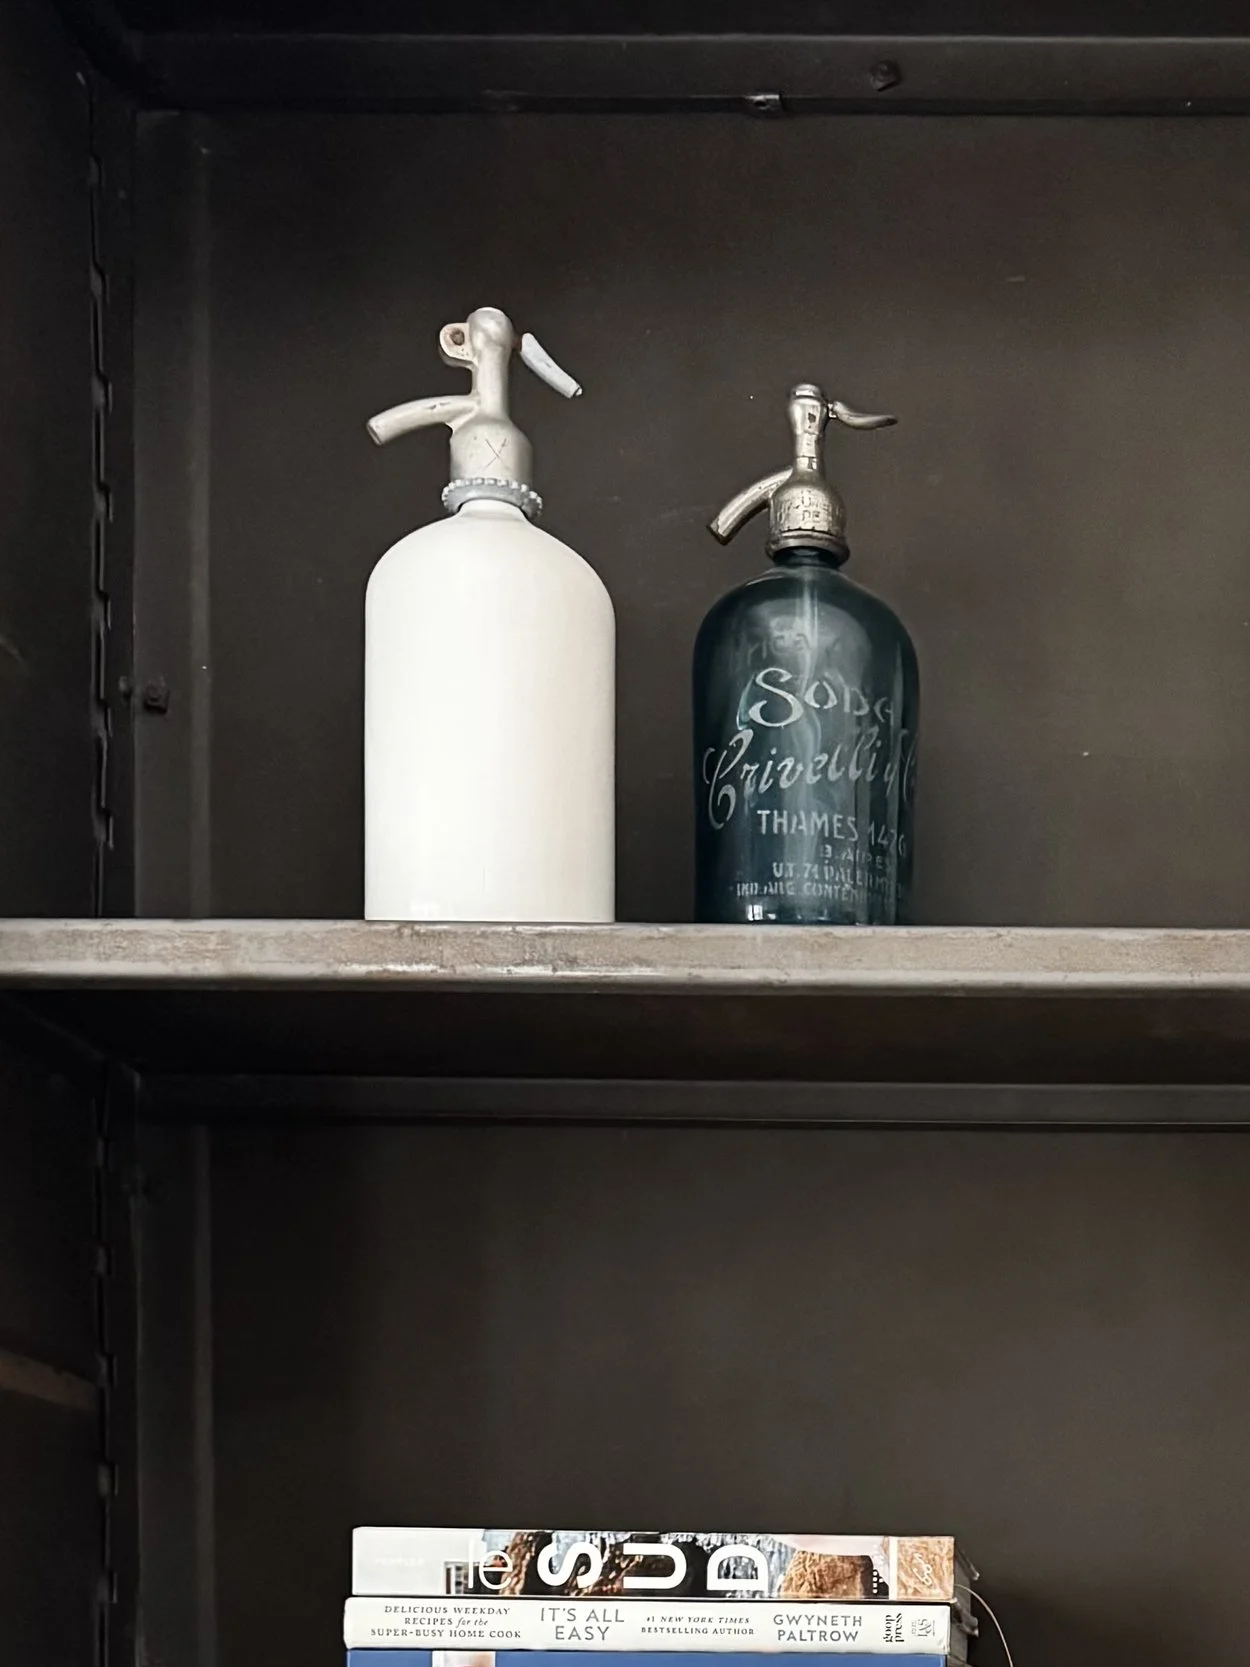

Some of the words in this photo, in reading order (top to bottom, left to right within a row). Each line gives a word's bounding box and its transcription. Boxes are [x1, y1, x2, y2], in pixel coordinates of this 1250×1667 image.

[757, 809, 859, 842] THAMES
[467, 1540, 513, 1590] le
[537, 1541, 769, 1591] SUD
[384, 1605, 449, 1615] DELICIOUS
[453, 1607, 511, 1616] WEEKDAY
[541, 1607, 577, 1623] IT'S
[586, 1608, 626, 1624] ALL
[404, 1617, 453, 1626] RECIPES
[455, 1617, 471, 1629] for
[473, 1618, 489, 1627] the
[688, 1616, 714, 1624] YORK
[718, 1617, 751, 1625] TIMES
[772, 1613, 863, 1628] GWYNETH
[370, 1628, 445, 1638] SUPER-BUSY
[449, 1629, 485, 1638] HOME
[489, 1630, 522, 1639] COOK
[554, 1625, 610, 1641] EASY
[641, 1627, 709, 1635] BESTSELLING
[712, 1628, 755, 1636] AUTHOR
[776, 1629, 860, 1643] PALTROW
[883, 1615, 895, 1643] goop
